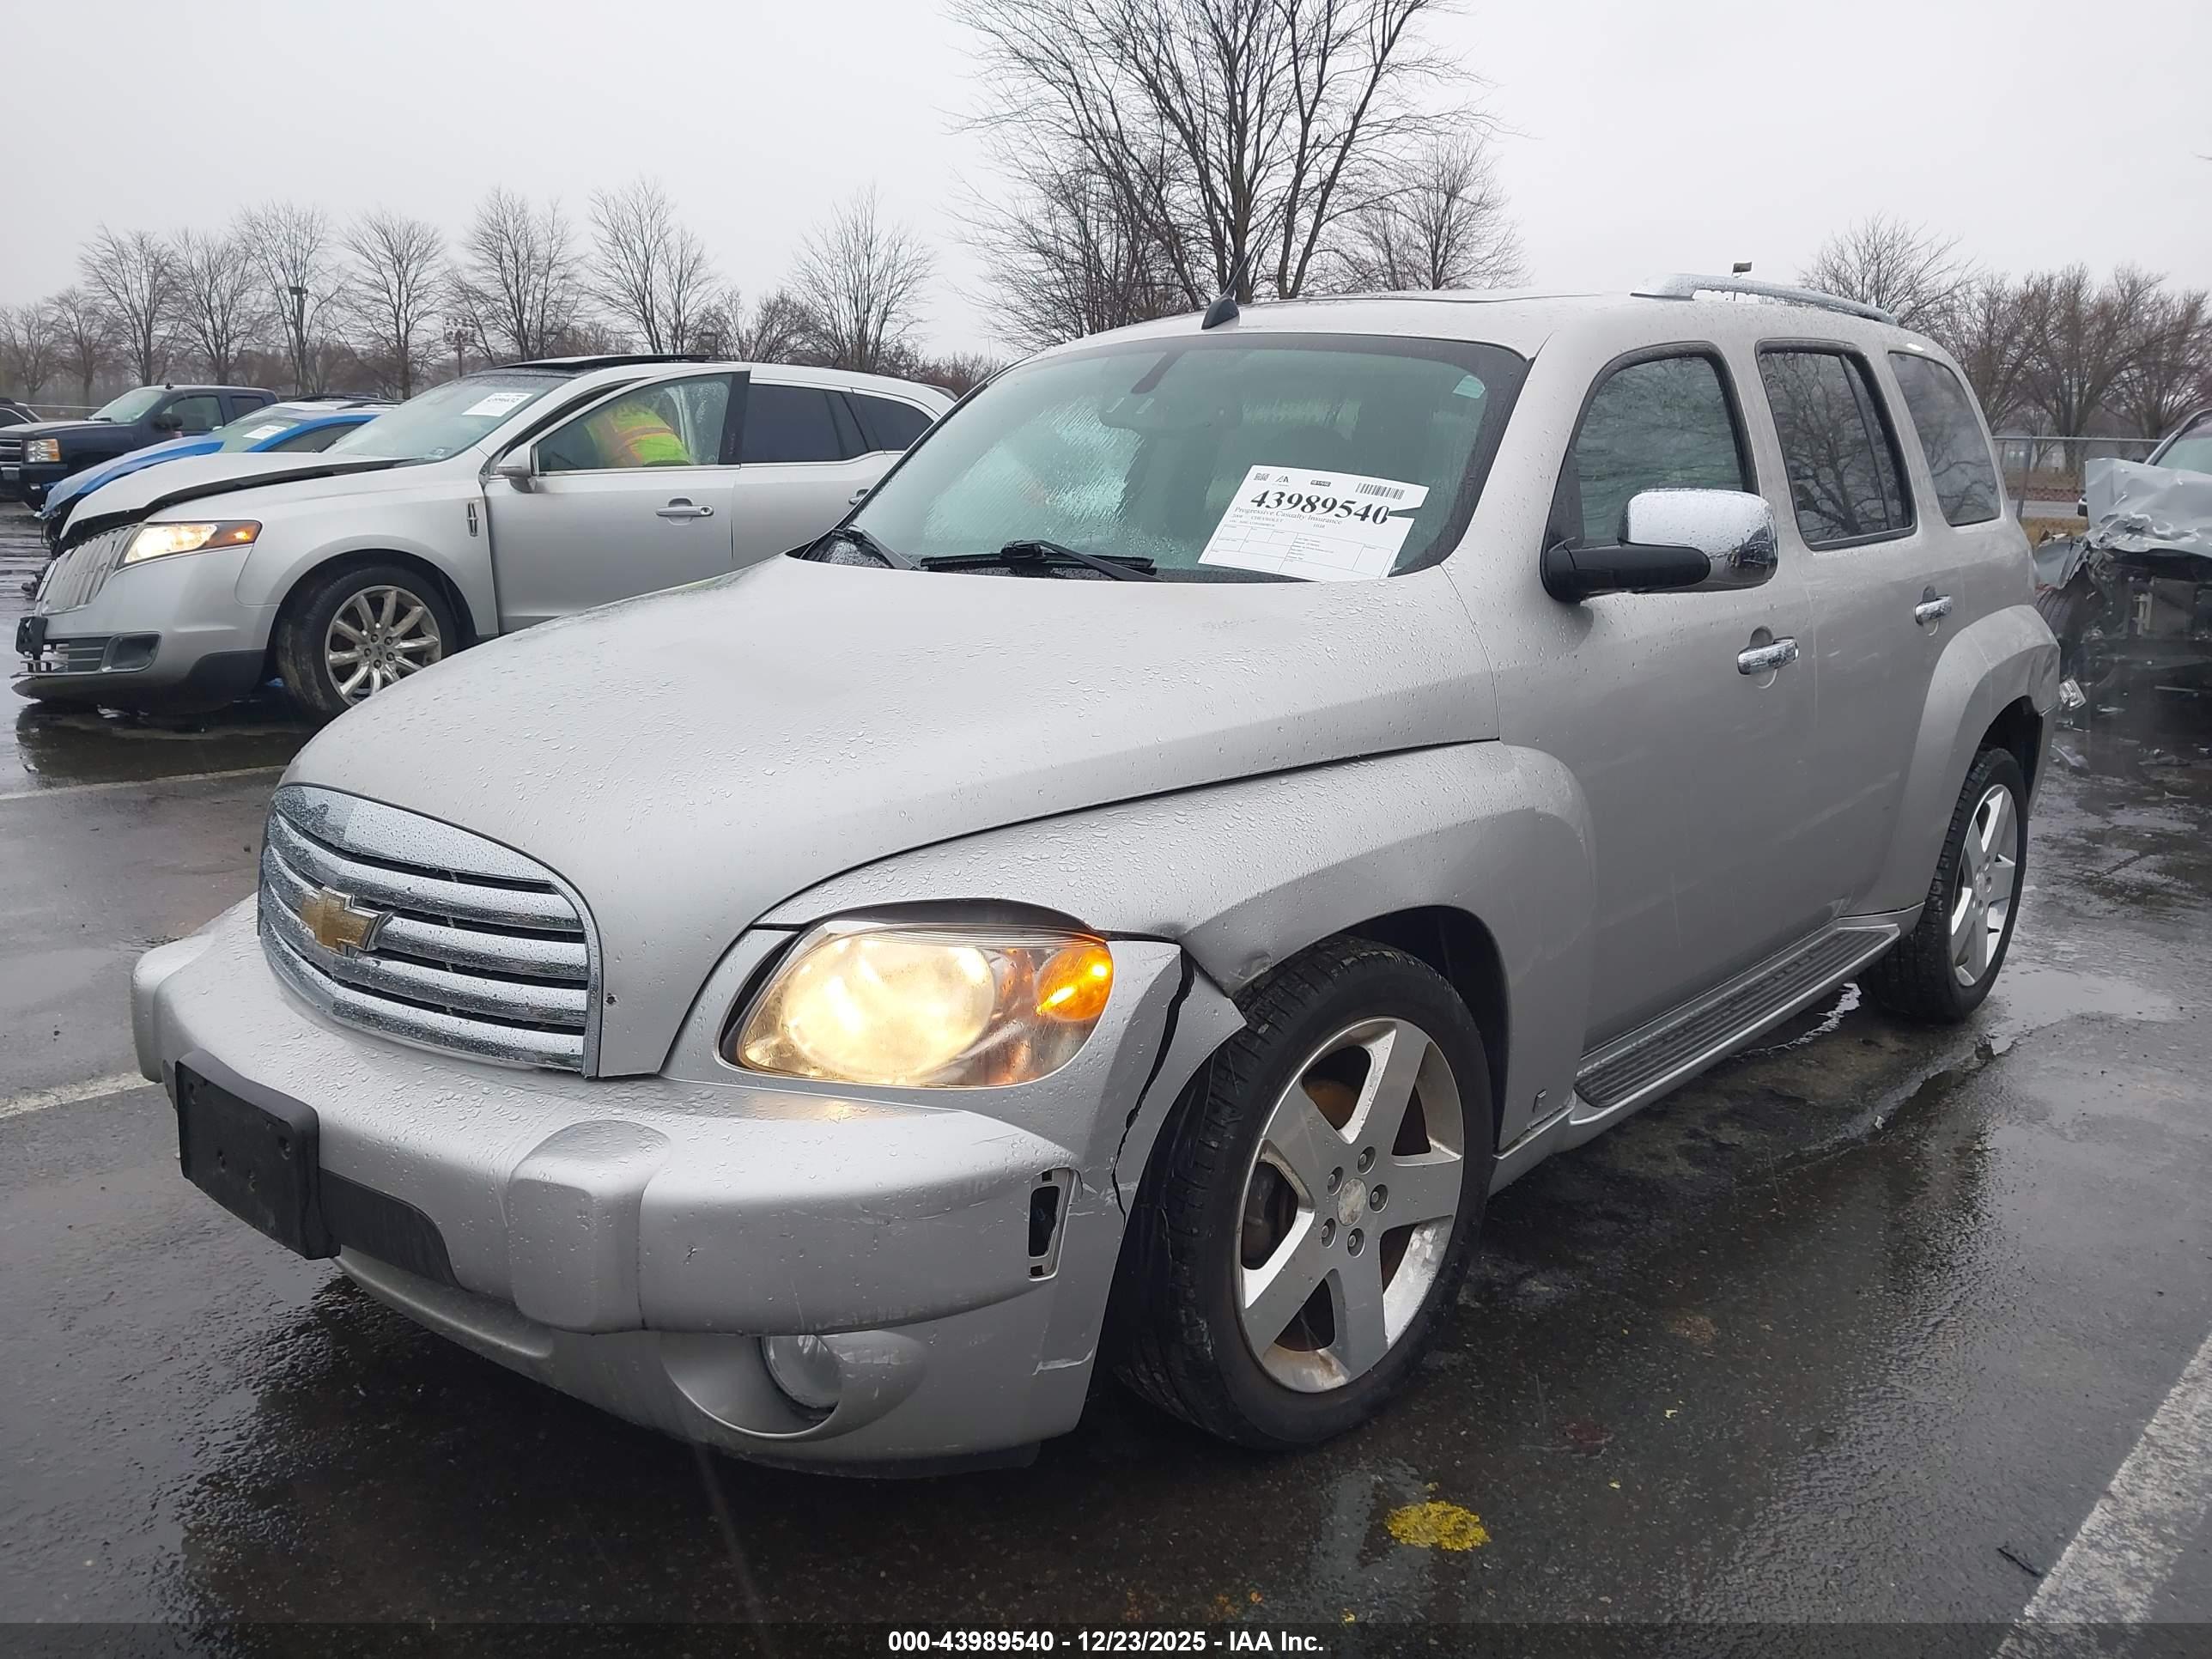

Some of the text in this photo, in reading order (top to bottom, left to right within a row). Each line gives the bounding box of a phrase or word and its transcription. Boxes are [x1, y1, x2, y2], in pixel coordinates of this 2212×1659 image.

[1235, 507, 1342, 525] Progressive Casualty Insurance
[1250, 489, 1389, 525] 43989540
